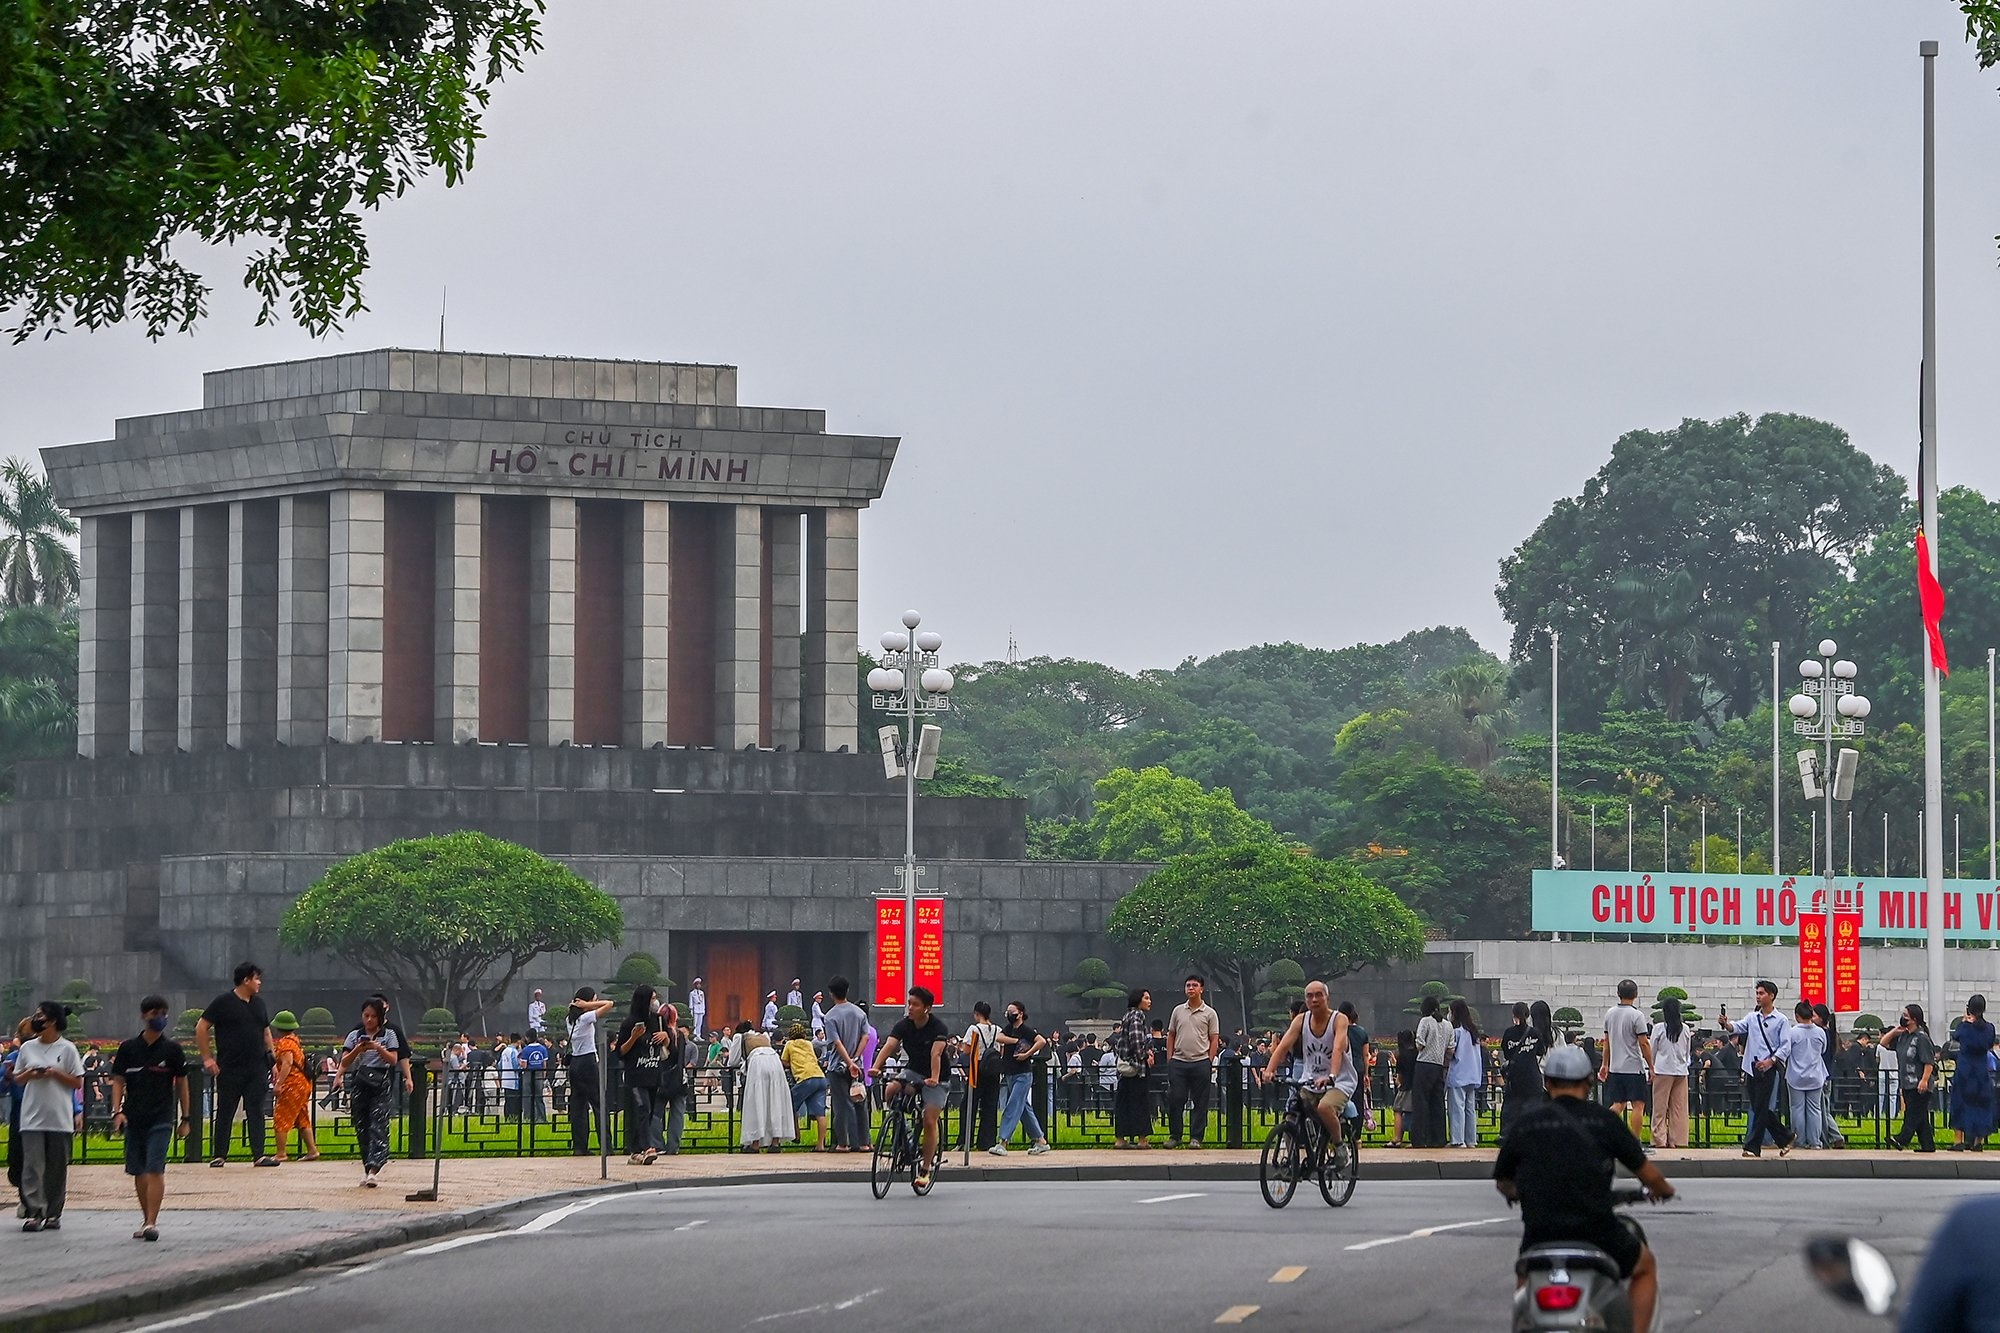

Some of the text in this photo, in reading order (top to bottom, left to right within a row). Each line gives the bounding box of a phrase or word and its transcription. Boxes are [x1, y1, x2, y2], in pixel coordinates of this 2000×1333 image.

[565, 426, 611, 445] CHỦ
[1592, 874, 1655, 924] CHỦ
[1670, 886, 1741, 932] TỊCH
[1756, 877, 1797, 926] HỒ
[881, 908, 901, 918] 27-7
[919, 907, 940, 917] 27-7
[1804, 941, 1820, 949] 27-7
